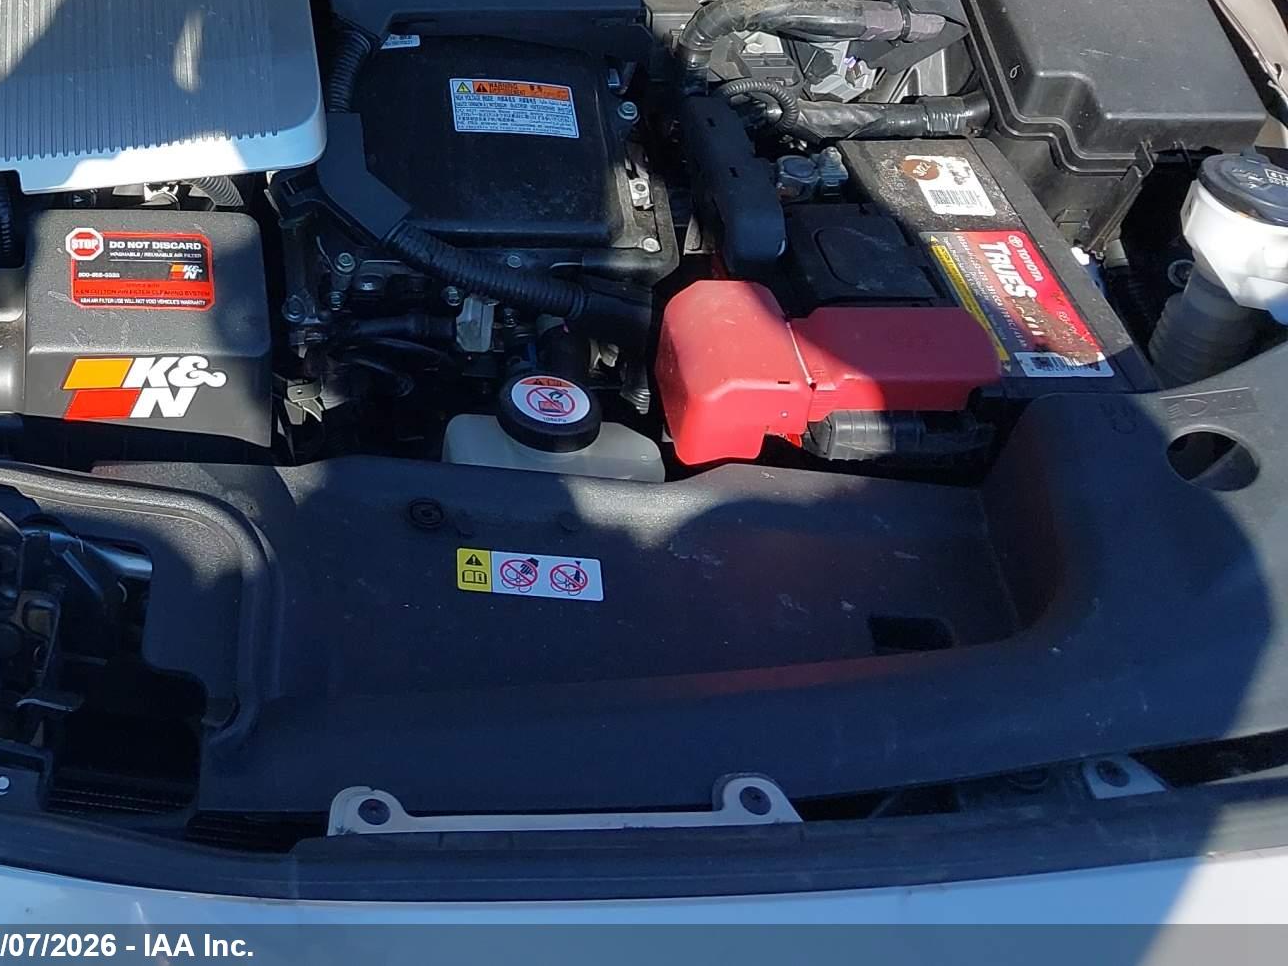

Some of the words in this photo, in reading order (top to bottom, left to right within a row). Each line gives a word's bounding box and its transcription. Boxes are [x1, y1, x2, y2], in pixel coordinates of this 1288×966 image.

[71, 239, 99, 249] STOP
[109, 241, 126, 249] DO
[127, 241, 151, 249] NOT
[152, 241, 202, 250] DISCARD
[1016, 247, 1044, 282] TOYOTA
[122, 355, 227, 418] K&N
